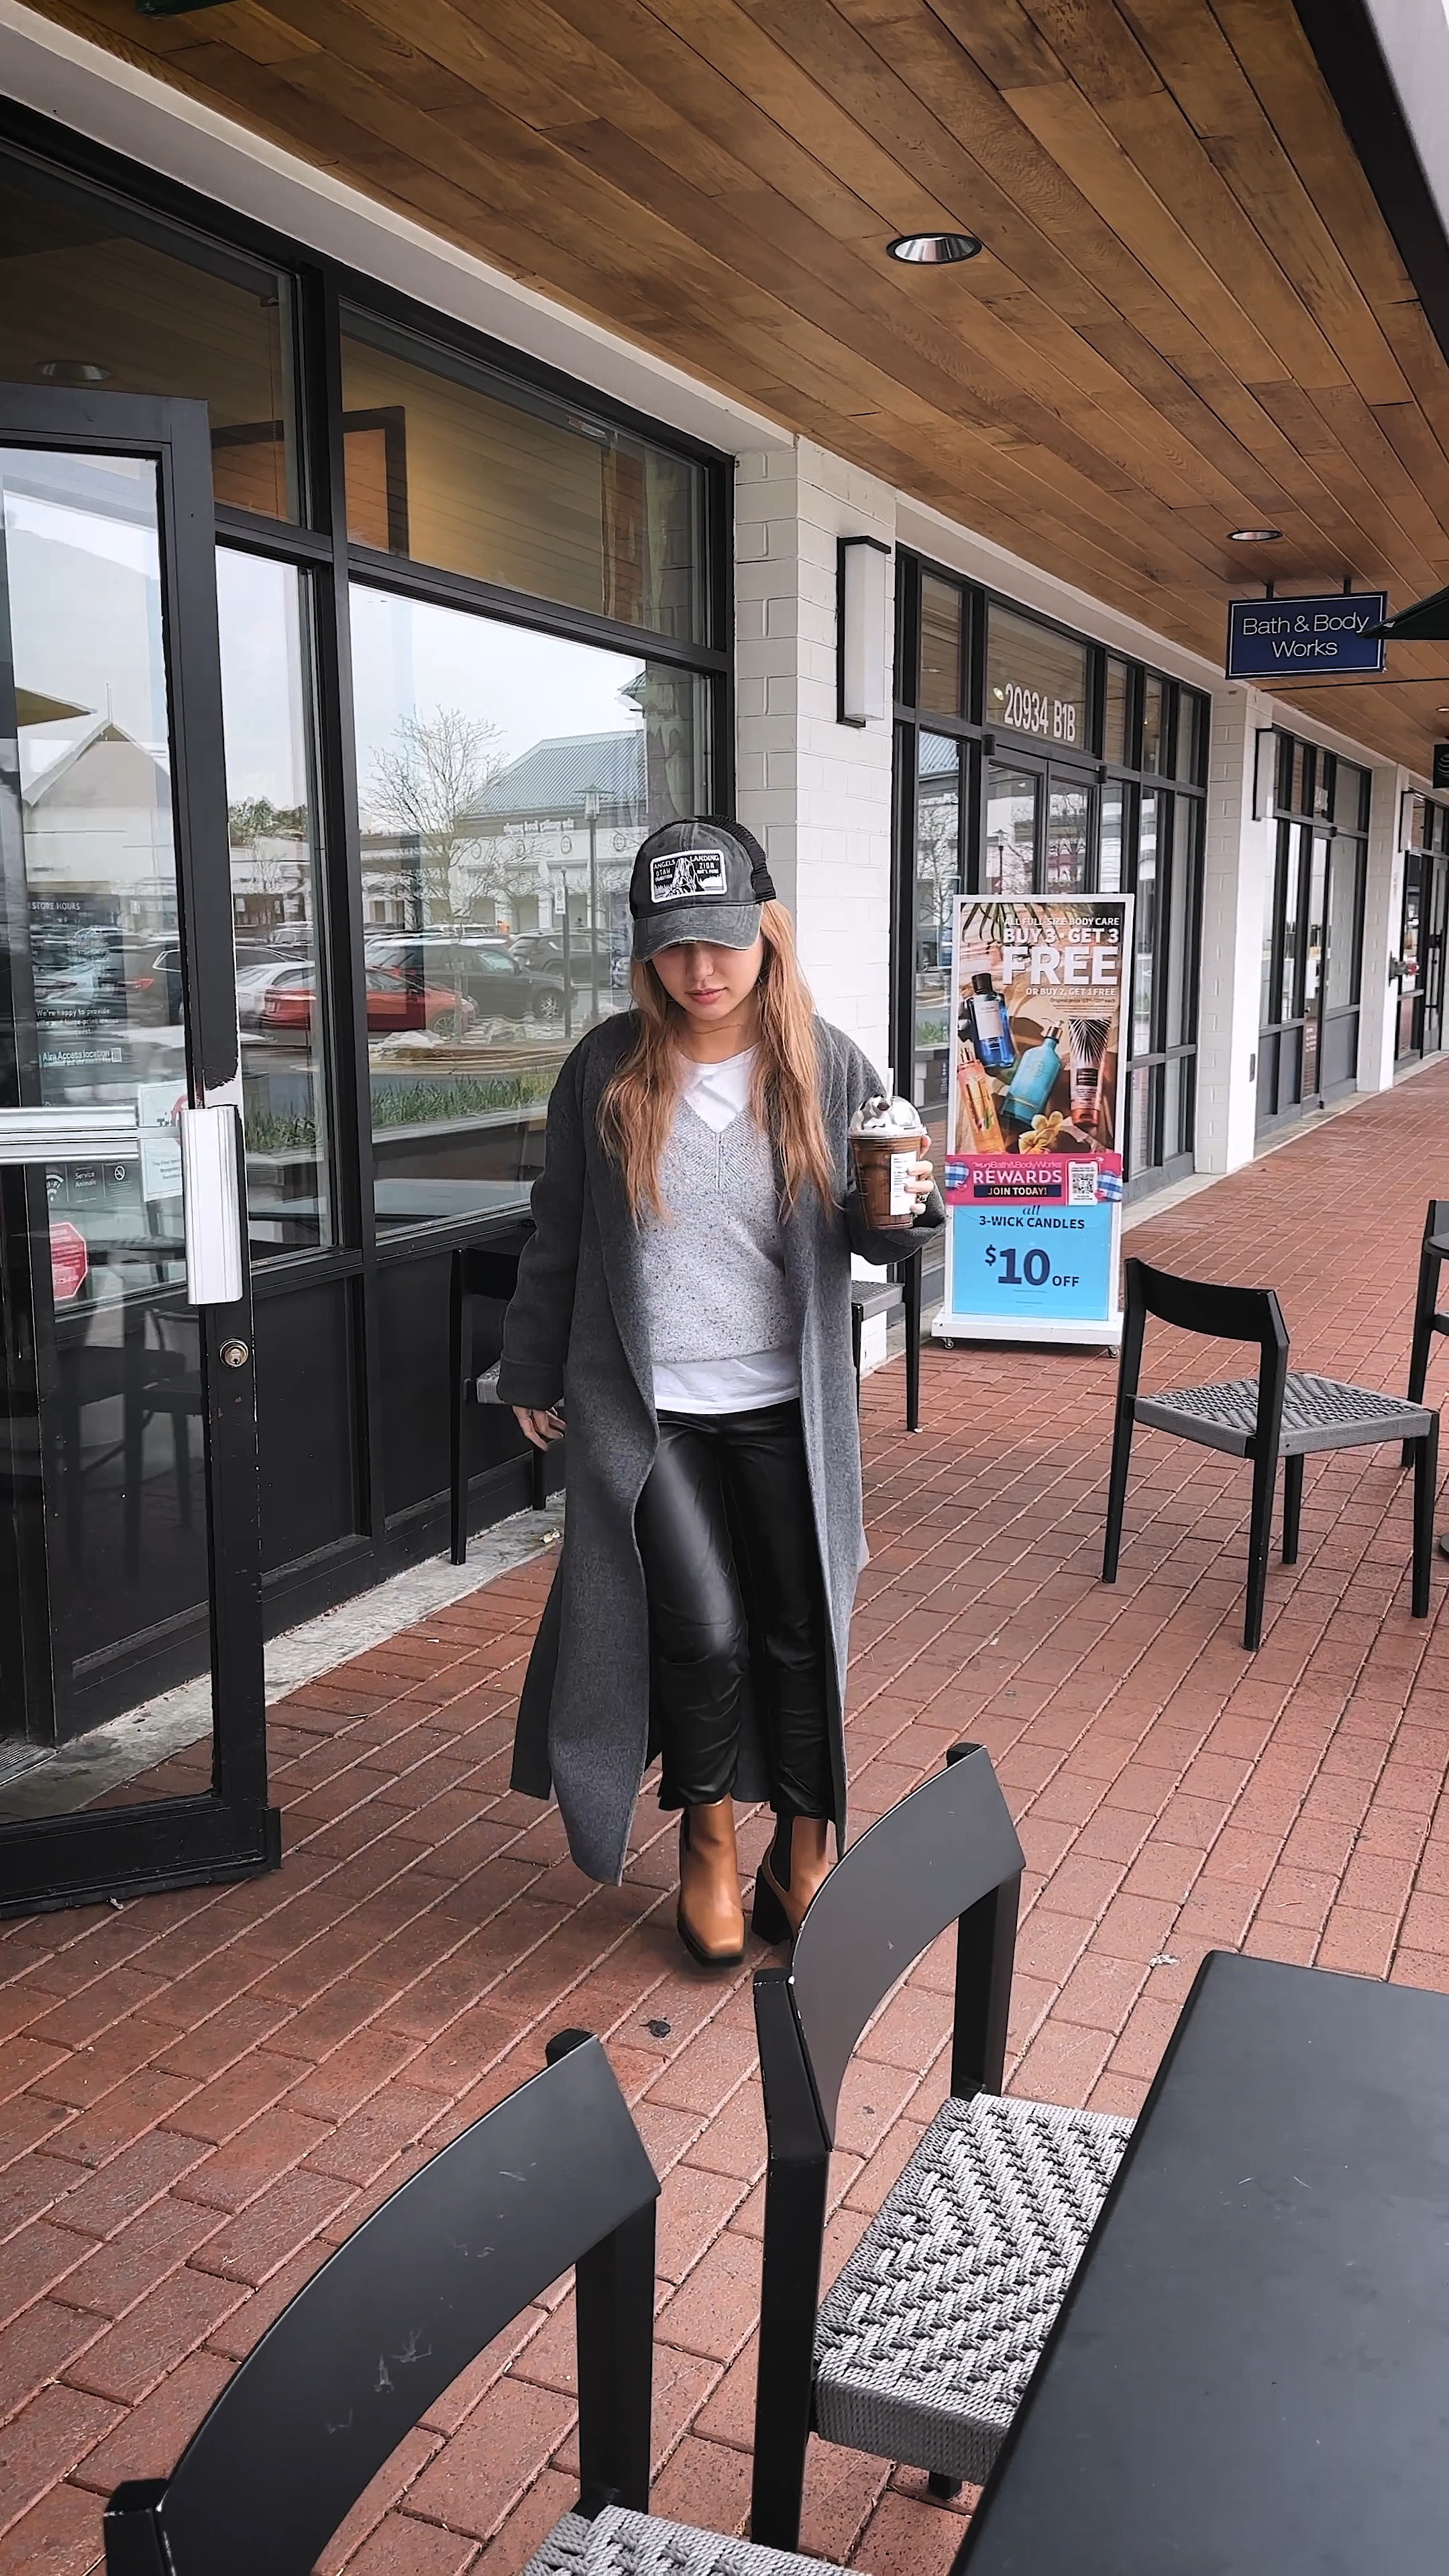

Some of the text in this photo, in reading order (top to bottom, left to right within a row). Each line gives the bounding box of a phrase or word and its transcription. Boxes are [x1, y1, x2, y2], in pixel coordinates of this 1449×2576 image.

[1242, 611, 1370, 636] Bath & Body
[1271, 639, 1338, 658] Works
[1004, 683, 1076, 742] 20934 B1B
[653, 859, 676, 870] ANGELS
[32, 902, 55, 910] STORE
[56, 902, 80, 911] HOURS
[1004, 917, 1120, 926] ALL FULL-SIZE BODY CARE
[1002, 928, 1120, 944] BUY 3 GET 3
[1002, 945, 1119, 985] FREE
[973, 1170, 1062, 1185] REWARDS
[987, 1187, 1048, 1196] JOIN TODAY!
[1022, 1205, 1040, 1216] all
[979, 1216, 1085, 1230] 3-WICK CANDLES
[984, 1244, 1080, 1287] $10 OFF
